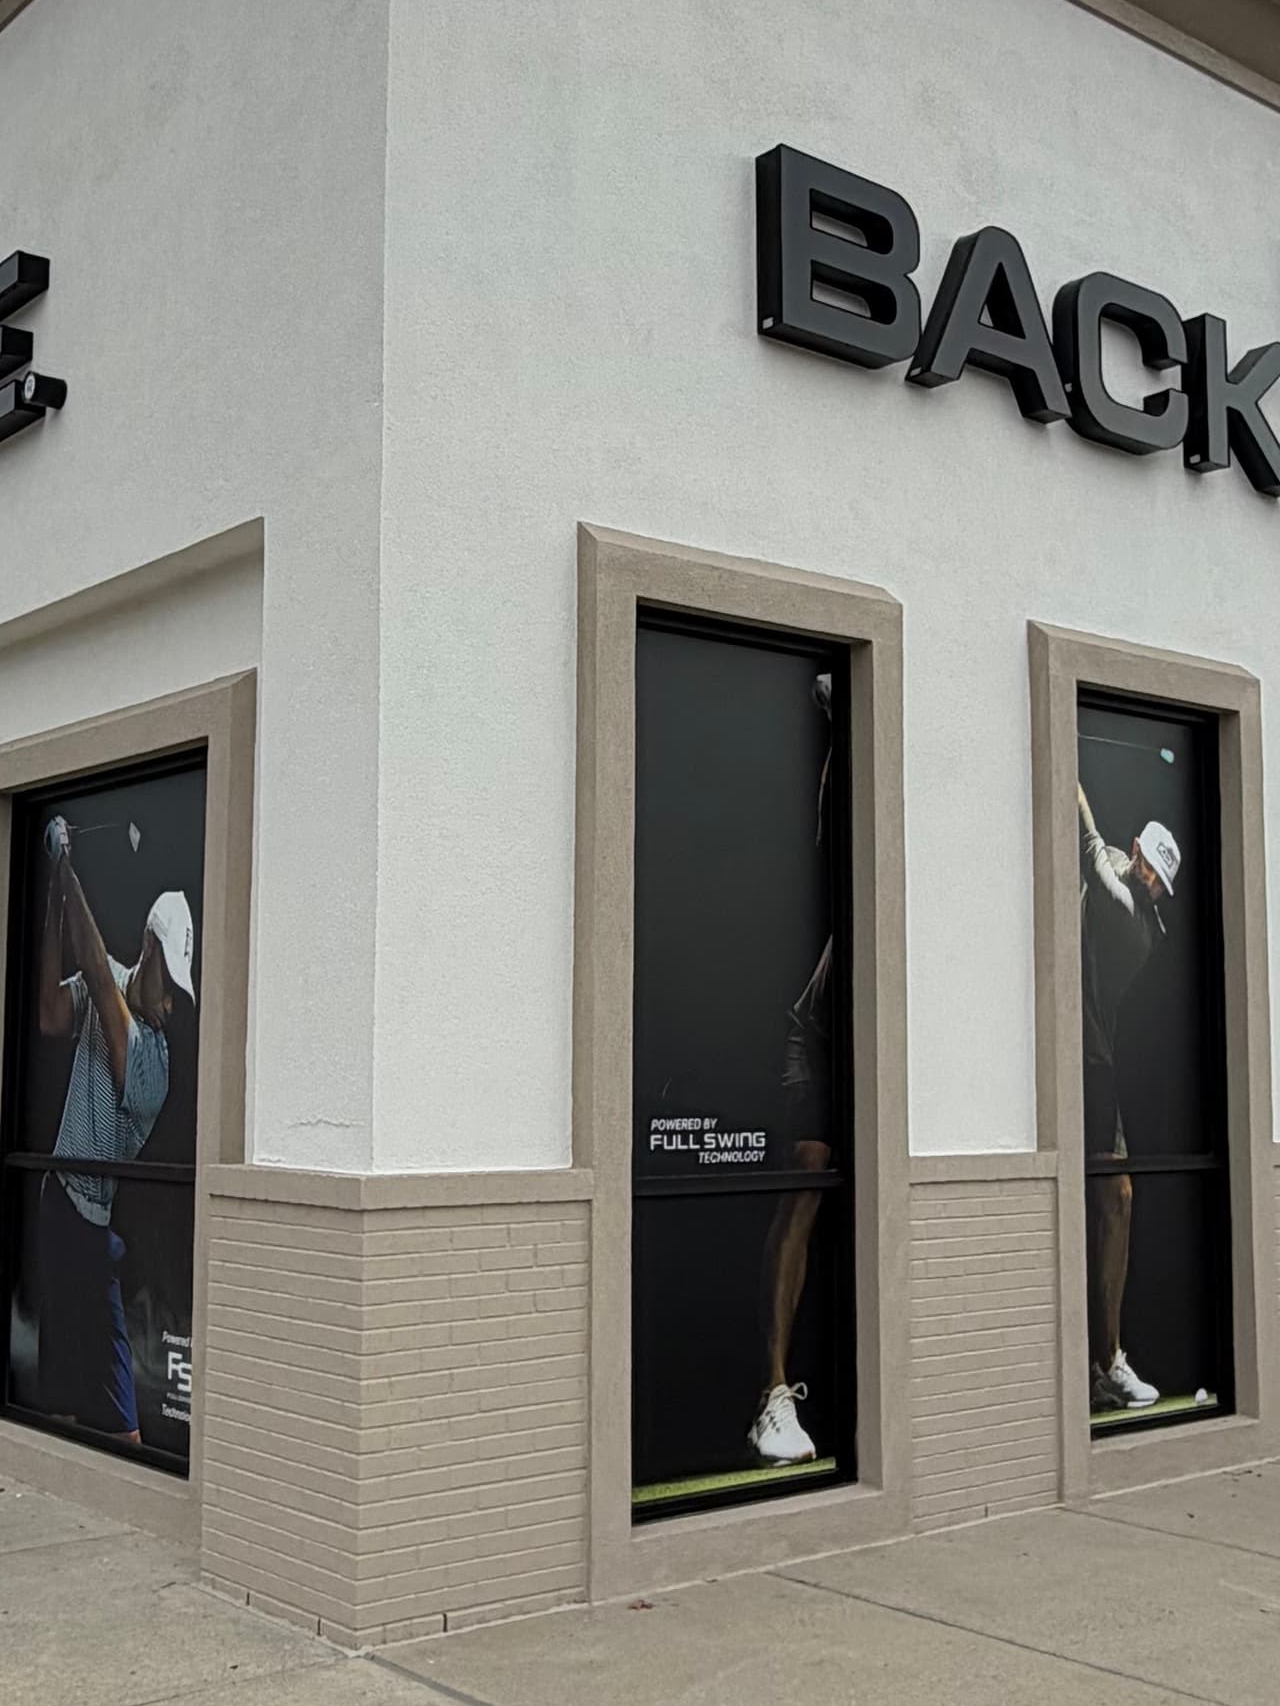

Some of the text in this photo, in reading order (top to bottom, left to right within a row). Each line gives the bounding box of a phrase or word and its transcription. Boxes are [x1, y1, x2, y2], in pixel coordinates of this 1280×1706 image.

[650, 1118, 718, 1131] POWERED BY
[650, 1132, 766, 1151] FULL SWING
[698, 1150, 766, 1164] TECHNOLOGY
